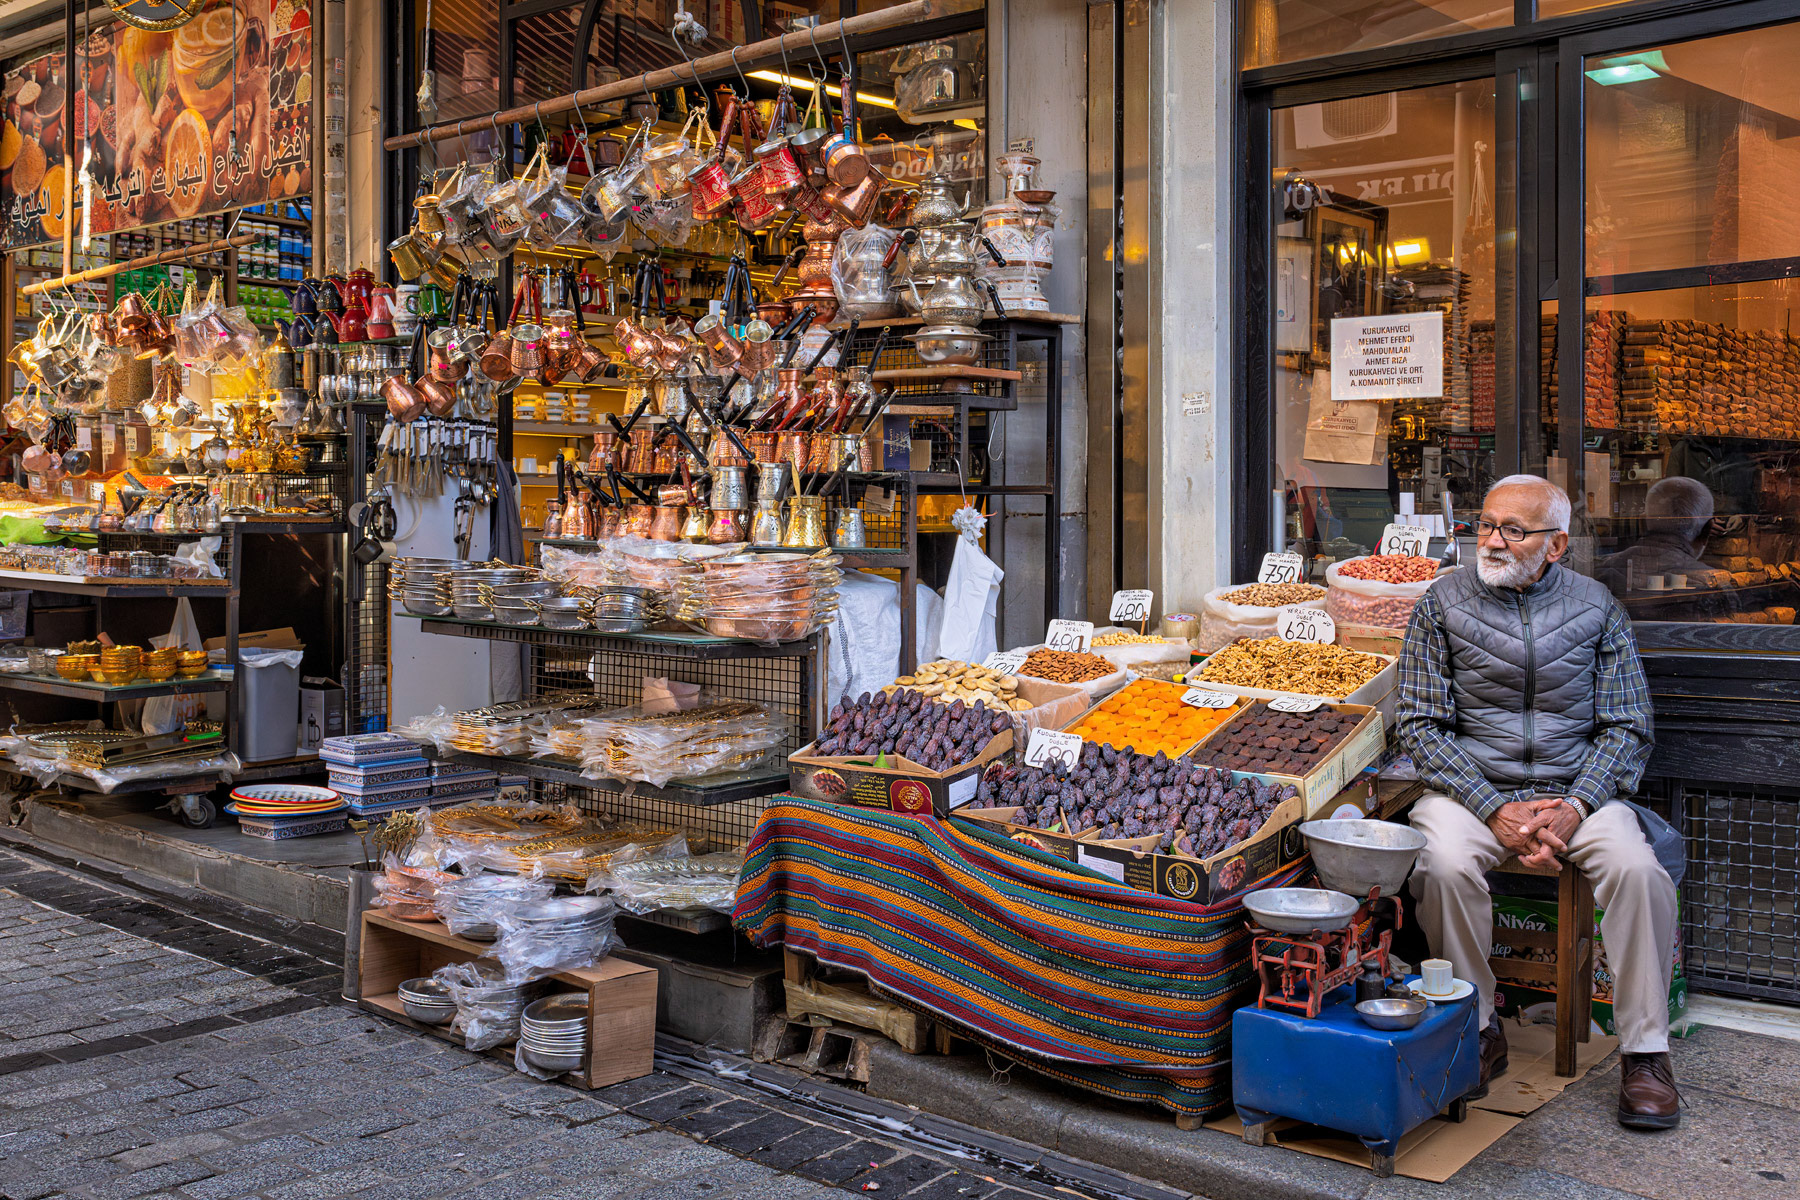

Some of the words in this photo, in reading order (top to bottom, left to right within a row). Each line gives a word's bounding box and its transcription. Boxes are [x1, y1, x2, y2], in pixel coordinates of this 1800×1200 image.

[261, 126, 308, 178] افضل
[213, 139, 255, 195] انواع
[11, 186, 51, 228] الملوك
[1362, 324, 1410, 335] KURUKAHVECİ
[1358, 336, 1388, 346] MEHMET
[1390, 334, 1415, 344] EFENDİ
[1362, 346, 1411, 356] MAHDUMLARI
[1349, 366, 1397, 376] KURUKAHVECİ
[1366, 358, 1390, 366] AHMET
[1358, 377, 1395, 386] KOMANDİT
[1397, 376, 1423, 386] ŞİRKETİ
[1387, 536, 1422, 557] 850
[1265, 564, 1295, 583] 750
[1115, 603, 1144, 621] 480
[1286, 621, 1316, 640] 620
[1050, 632, 1084, 653] 480
[1187, 695, 1224, 706] 440
[1271, 701, 1310, 711] 540
[1030, 744, 1074, 767] 480
[1498, 913, 1546, 931] Nivaz
[1491, 943, 1512, 958] ntep
